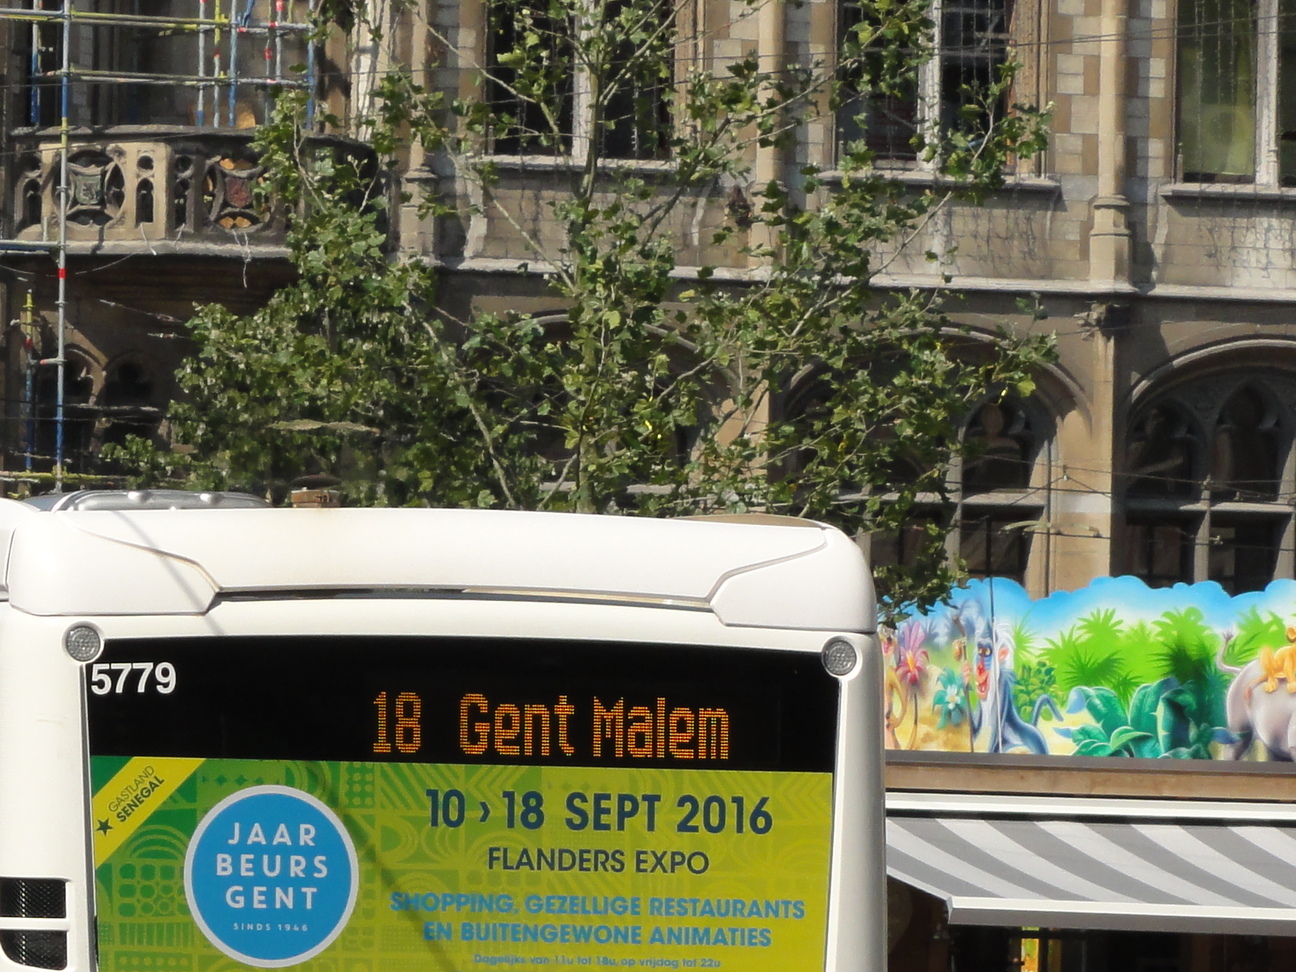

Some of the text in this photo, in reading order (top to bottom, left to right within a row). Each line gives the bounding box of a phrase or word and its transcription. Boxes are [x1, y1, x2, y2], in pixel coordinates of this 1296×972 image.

[91, 661, 177, 695] 5779
[373, 691, 730, 760] 18 Gent Malem
[108, 765, 155, 813] GASTLAND
[116, 775, 166, 823] SENEGAL
[425, 788, 774, 836] 10 18 SEPT 2016
[227, 822, 317, 847] JAAR
[216, 853, 328, 878] BEURS
[487, 846, 710, 875] FLANDERS EXPO
[225, 885, 318, 910] GENT
[390, 891, 805, 920] SHOPPING, GEZELLIGE RESTAURANTS
[233, 922, 308, 932] SINDS 1946
[423, 920, 772, 948] EN BUITENGEWONE ANIMATIES
[473, 953, 526, 967] Dagelijks
[530, 956, 550, 965] van
[577, 955, 592, 966] tot
[620, 957, 636, 968] op
[639, 957, 679, 970] vrijdag
[681, 957, 698, 968] tot
[700, 957, 721, 968] 22u
